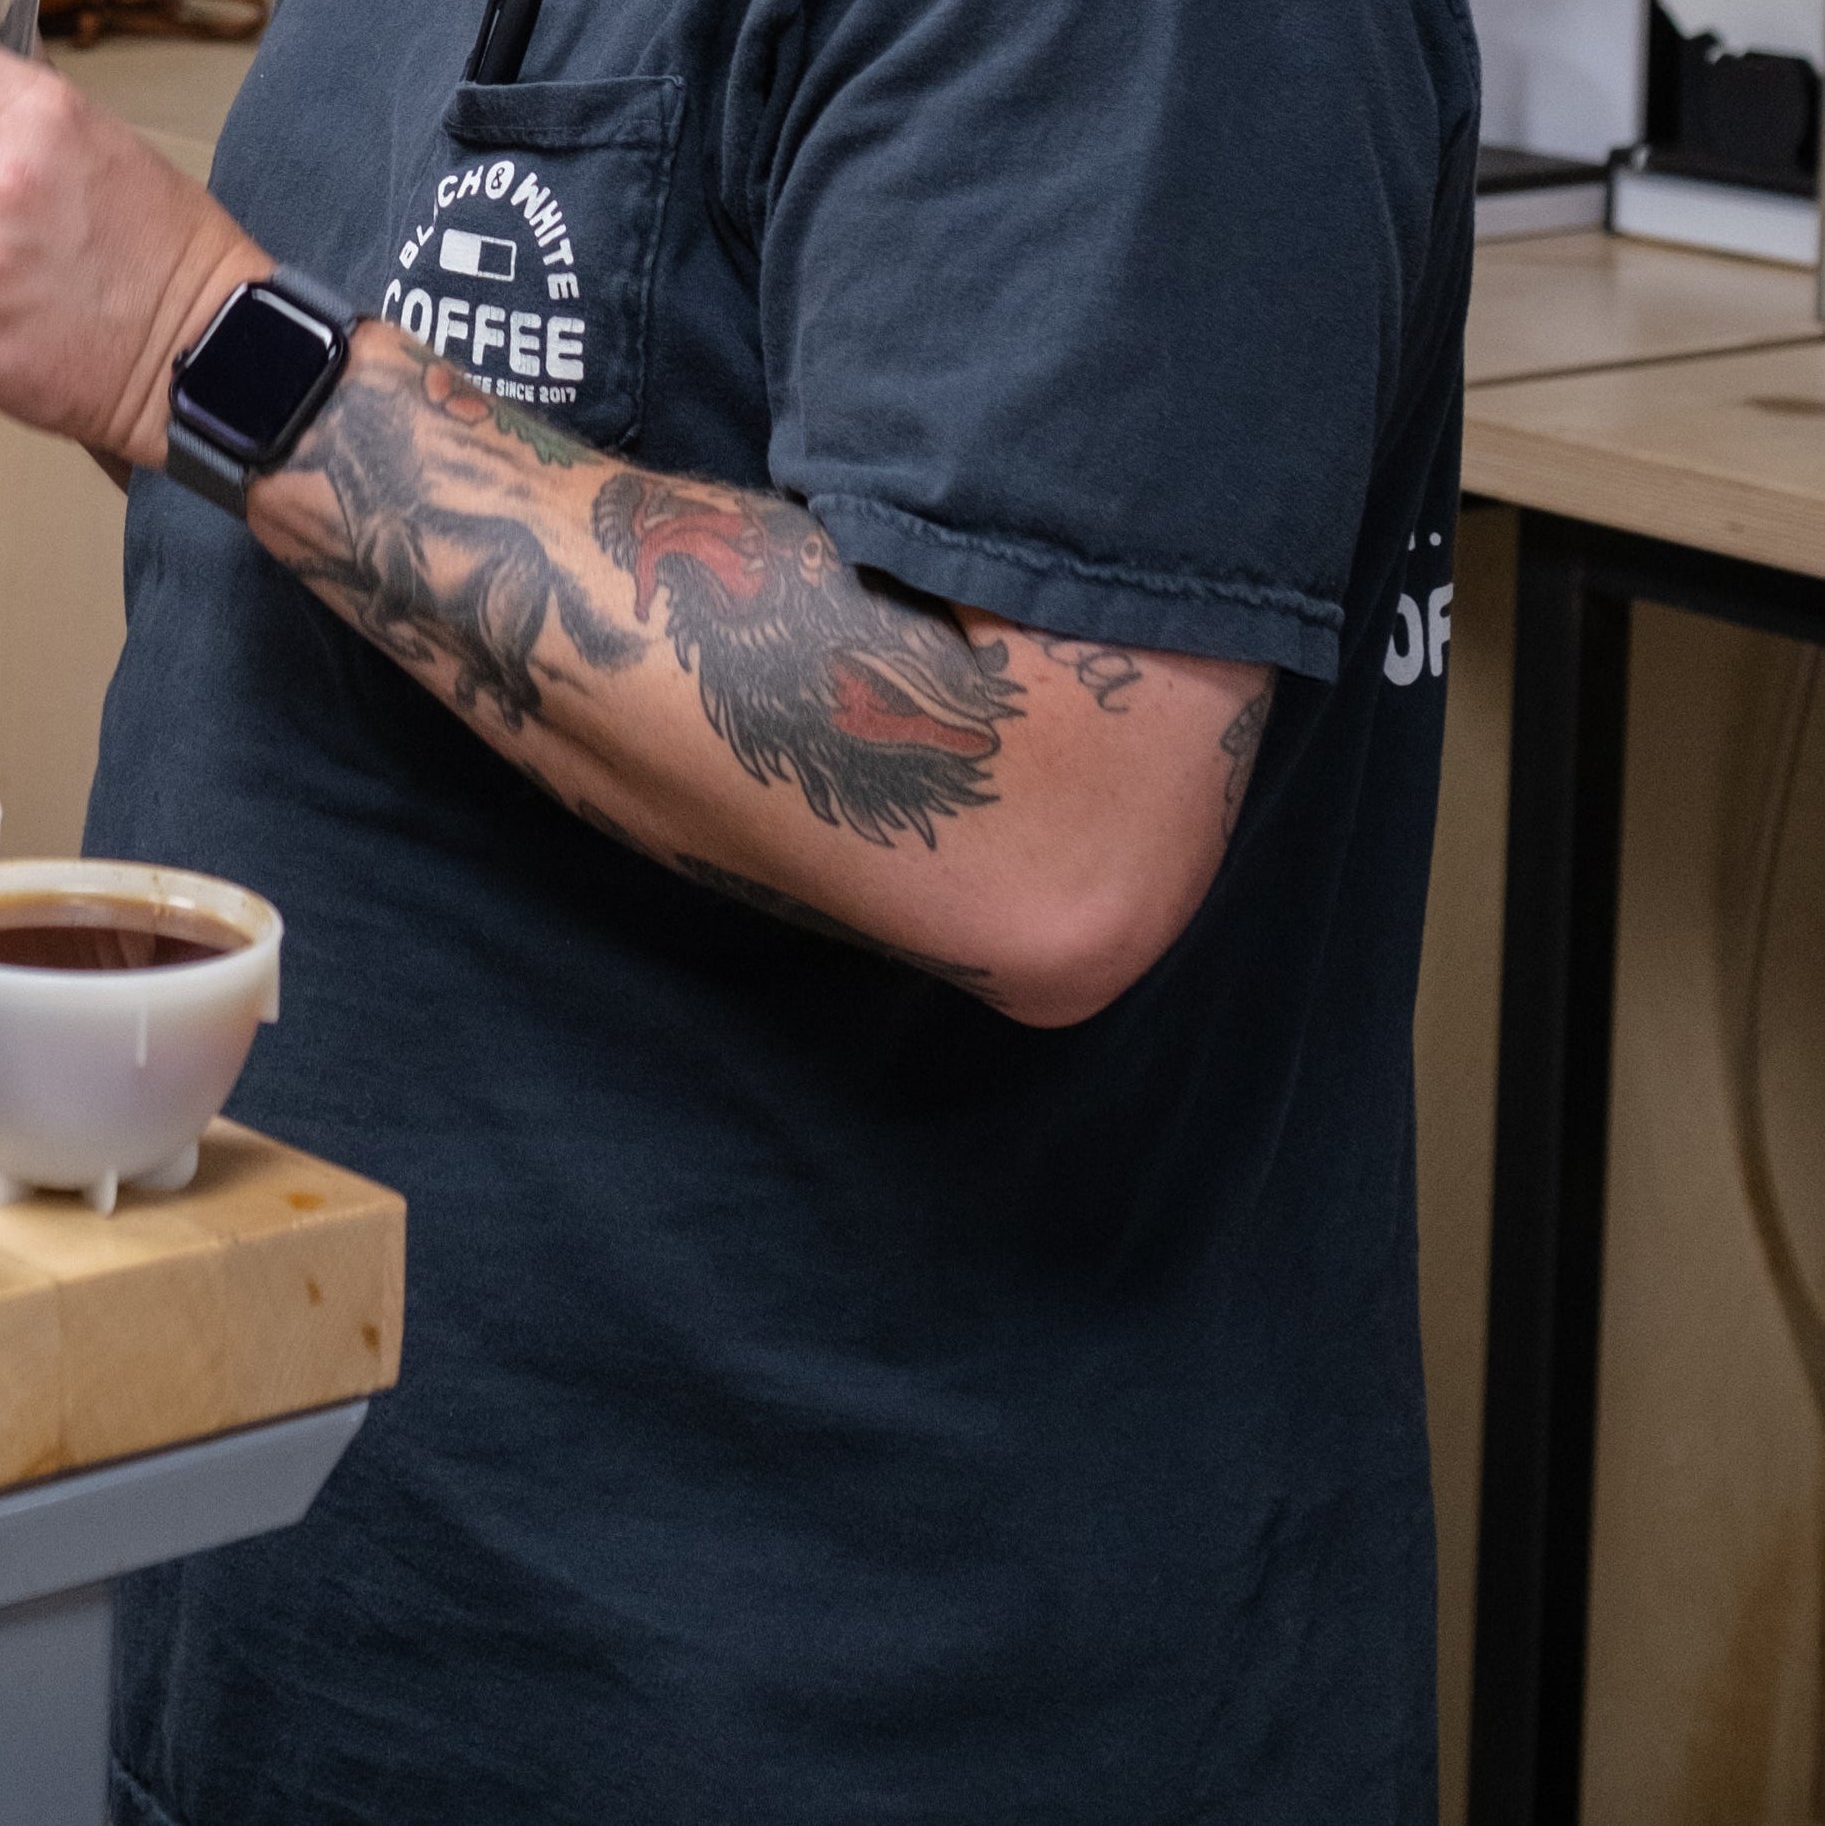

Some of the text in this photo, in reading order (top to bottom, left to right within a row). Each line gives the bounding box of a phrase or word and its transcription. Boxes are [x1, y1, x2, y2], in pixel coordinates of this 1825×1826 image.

[399, 164, 485, 270] BLCK
[510, 171, 580, 301] WHITE
[495, 378, 535, 403] SINCE
[538, 386, 577, 404] 2017
